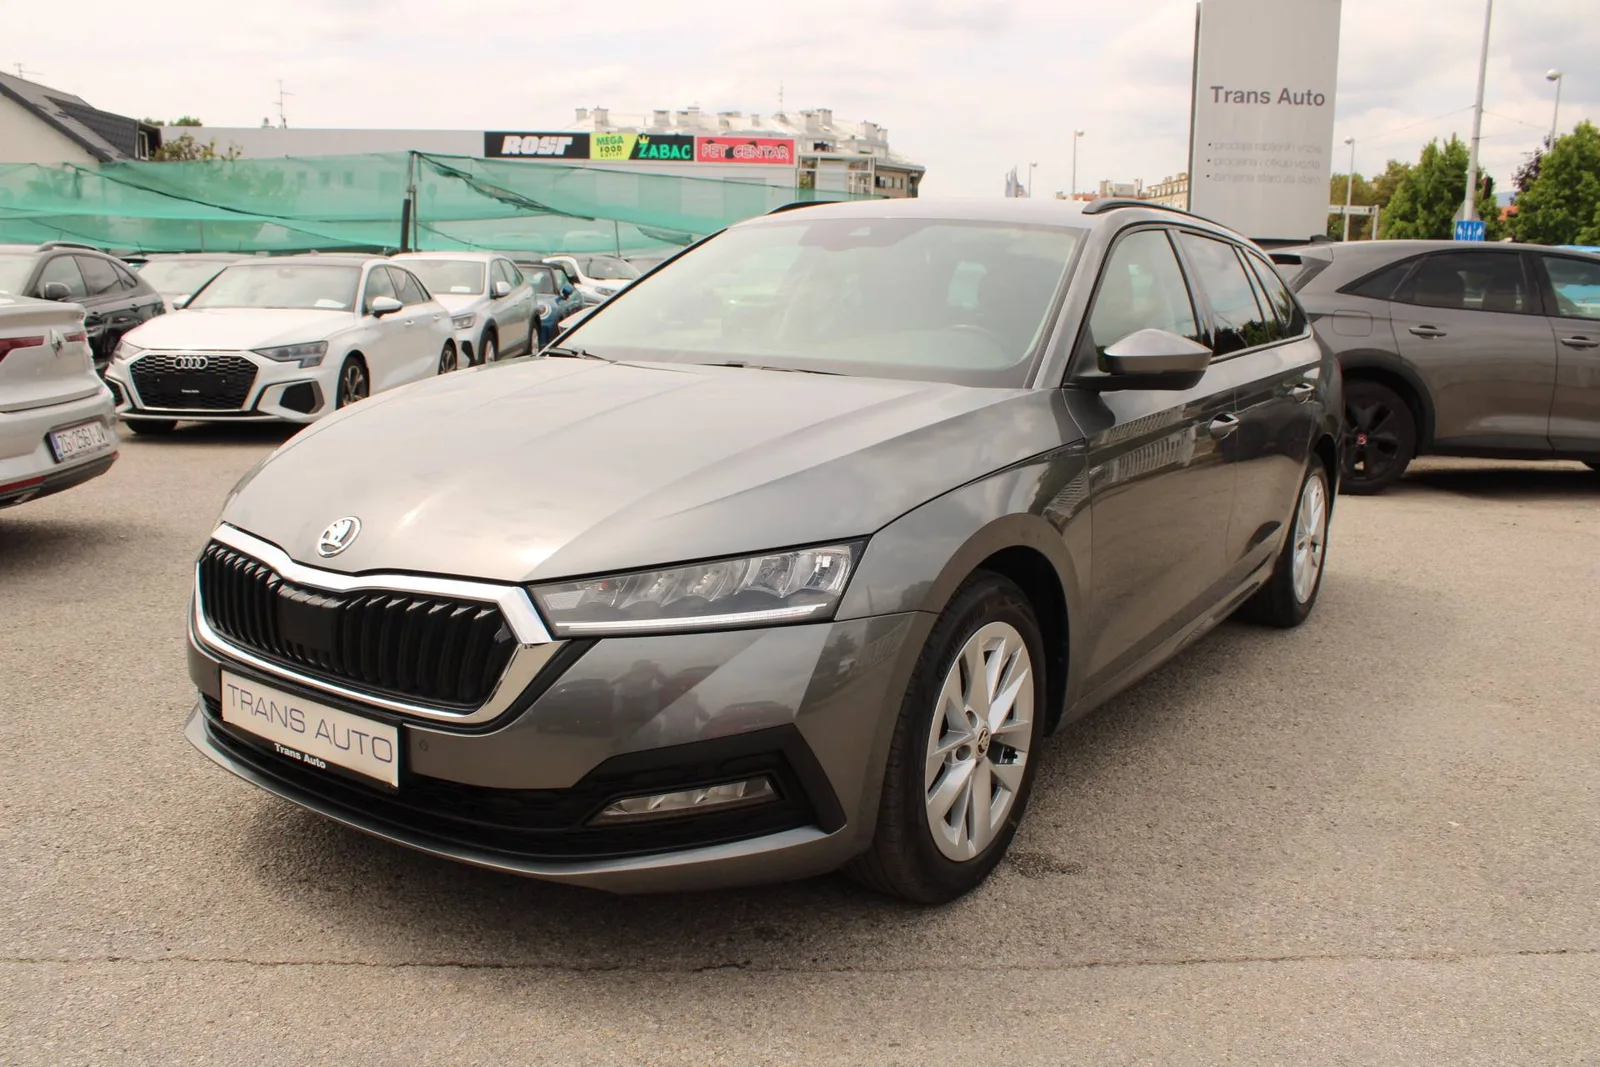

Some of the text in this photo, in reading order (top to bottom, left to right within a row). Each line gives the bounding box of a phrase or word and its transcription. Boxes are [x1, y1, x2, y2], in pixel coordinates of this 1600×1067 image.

[1210, 86, 1325, 107] Trans Auto
[596, 135, 624, 146] MEGA
[600, 145, 622, 153] FOOD
[701, 143, 789, 159] PET CENTAR
[57, 434, 73, 454] ZG
[227, 684, 393, 763] TRANS AUTO
[274, 742, 327, 770] Trans Auto
